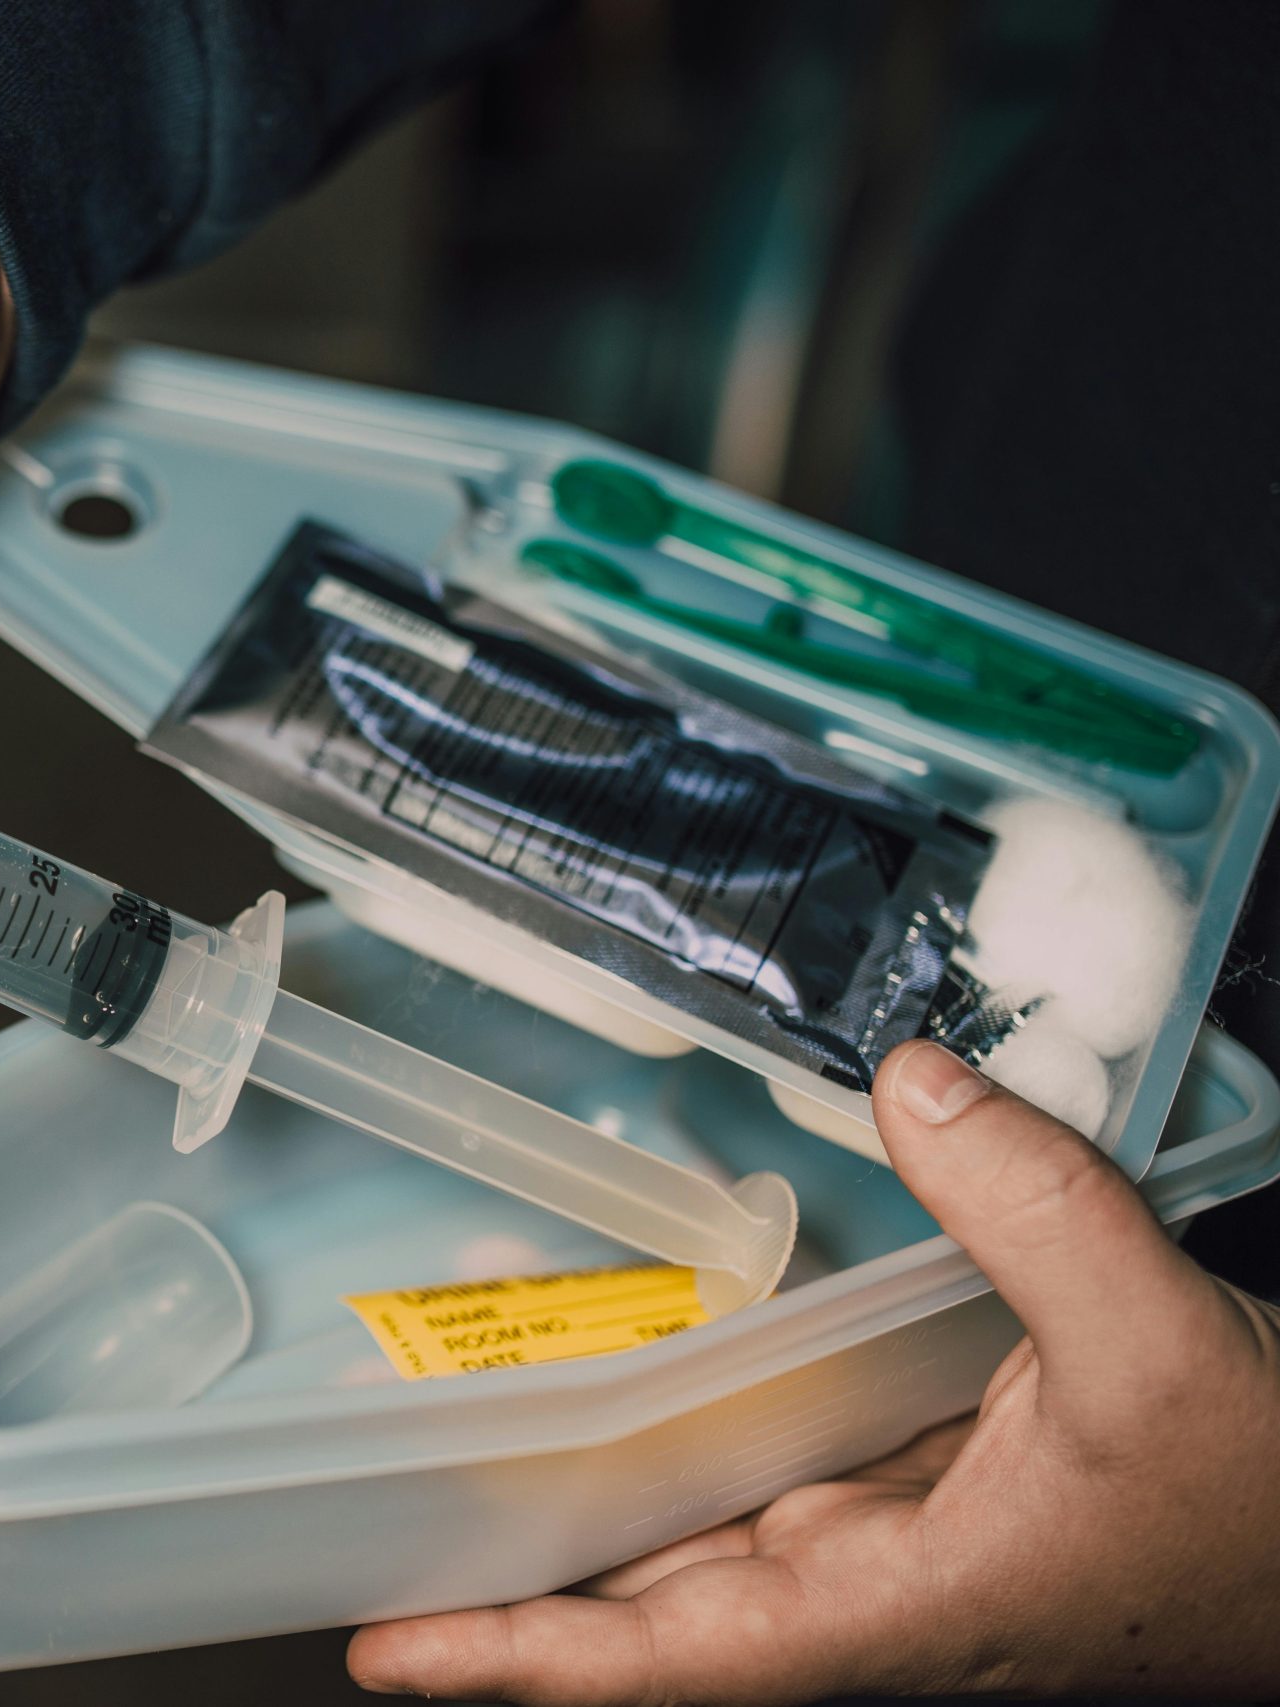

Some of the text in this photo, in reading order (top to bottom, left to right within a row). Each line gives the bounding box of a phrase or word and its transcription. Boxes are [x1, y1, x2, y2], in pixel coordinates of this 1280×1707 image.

[29, 855, 61, 896] 25
[109, 892, 139, 932] 30
[425, 1304, 502, 1332] NAME
[442, 1325, 526, 1353] ROOM
[460, 1350, 523, 1374] DATE
[678, 1454, 724, 1483] 600
